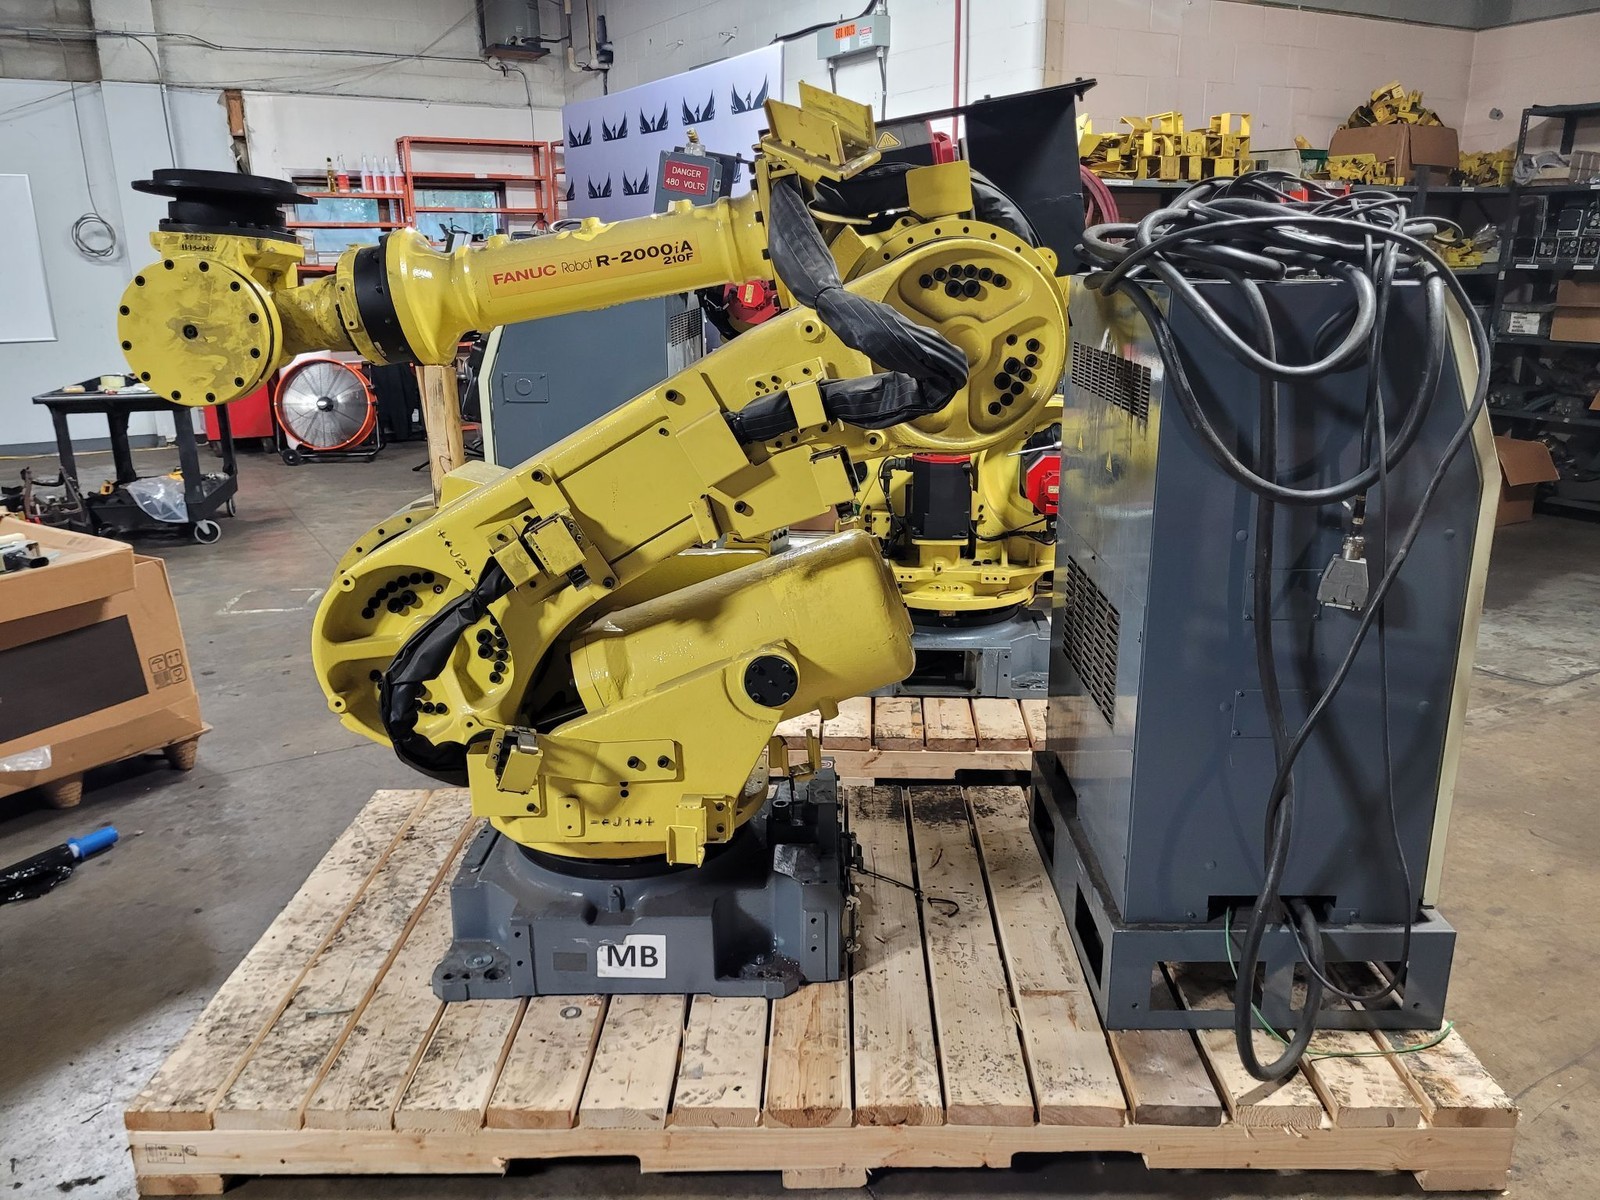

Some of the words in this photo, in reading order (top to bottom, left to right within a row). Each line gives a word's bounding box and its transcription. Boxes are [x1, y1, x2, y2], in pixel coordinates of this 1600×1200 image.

[671, 166, 702, 178] DANGER
[665, 177, 680, 187] 480
[683, 180, 706, 191] VOLTS
[493, 264, 557, 285] FANUC
[561, 257, 593, 274] Robot
[596, 240, 693, 267] R-2000iA
[663, 252, 694, 265] 210F
[607, 945, 659, 968] MB
